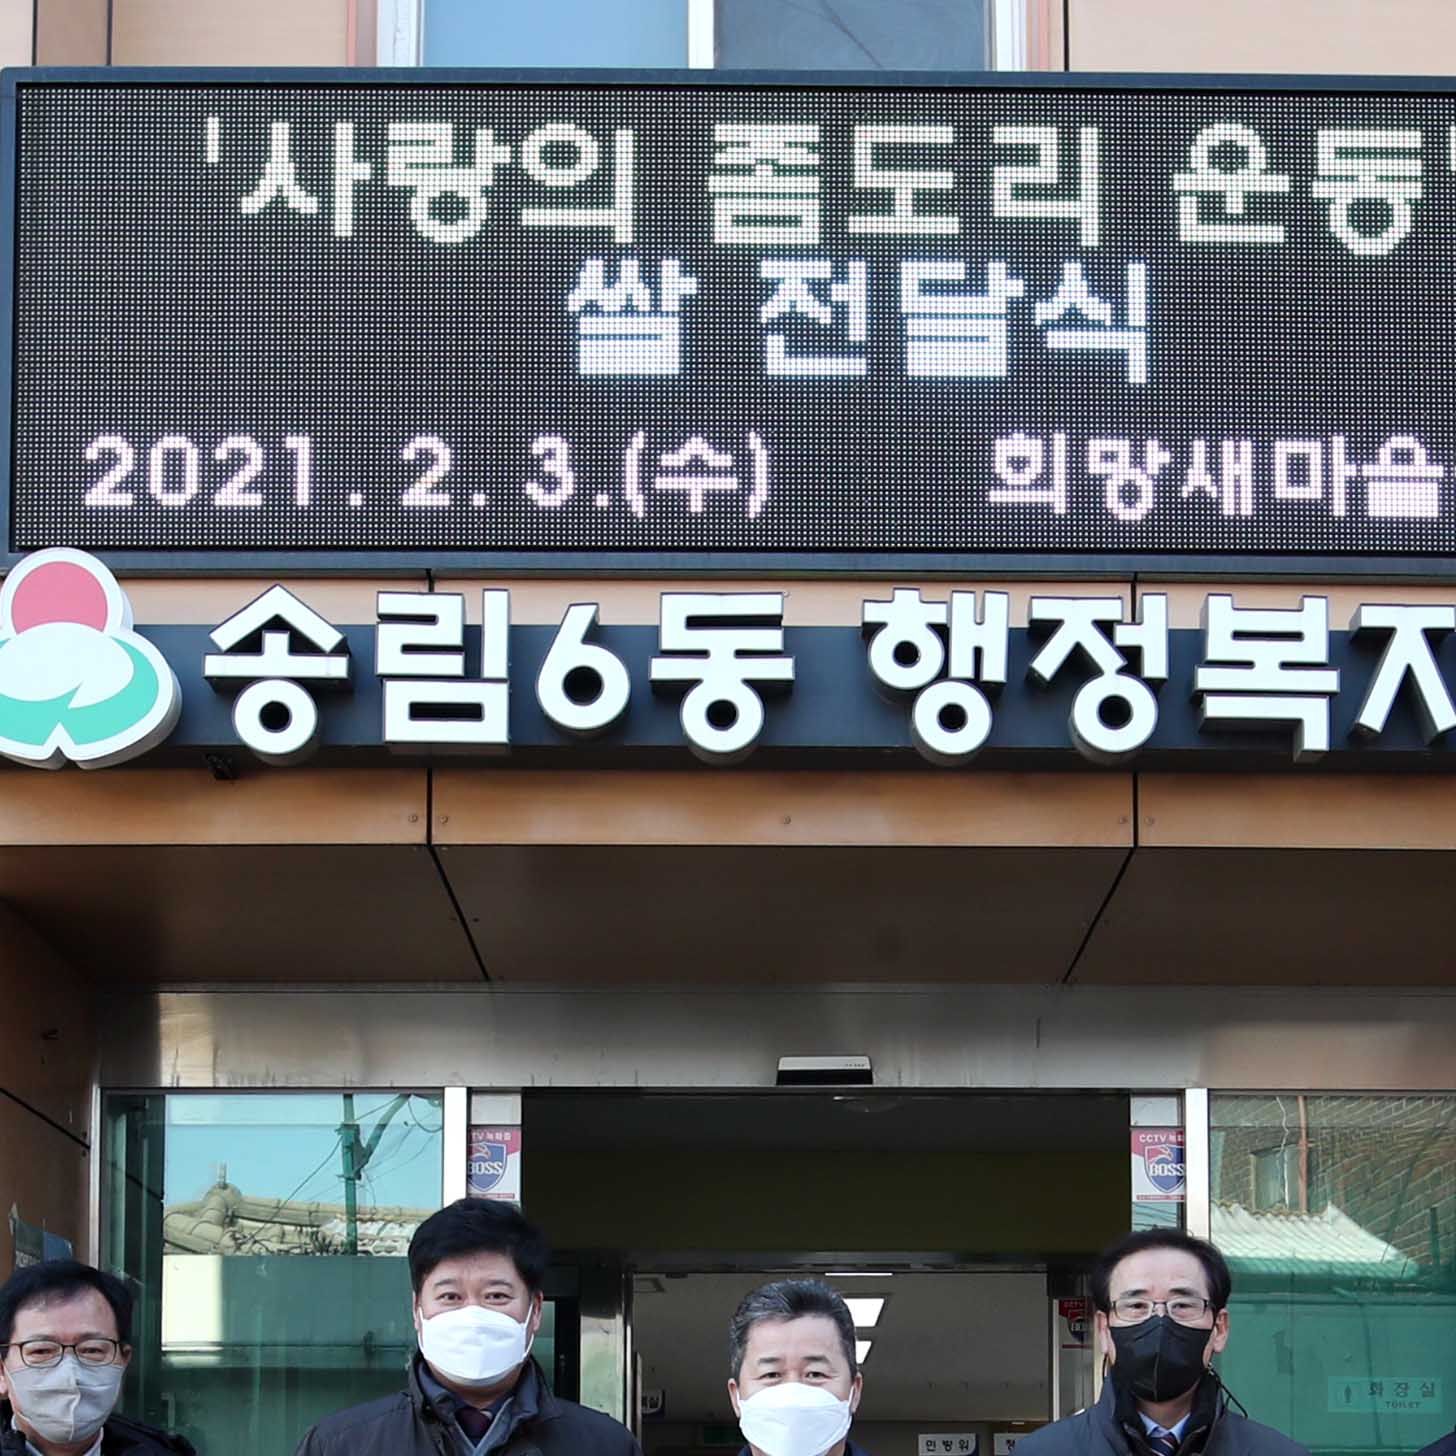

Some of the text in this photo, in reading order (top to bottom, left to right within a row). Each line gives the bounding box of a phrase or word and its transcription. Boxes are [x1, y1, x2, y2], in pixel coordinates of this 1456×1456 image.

[206, 116, 634, 245] '사랑의
[708, 123, 1098, 247] 좀도리
[566, 258, 1147, 384] 쌀 전달식
[202, 583, 795, 767] 송림6동
[1139, 1134, 1167, 1143] CCTV
[1149, 1163, 1184, 1177] BOSS
